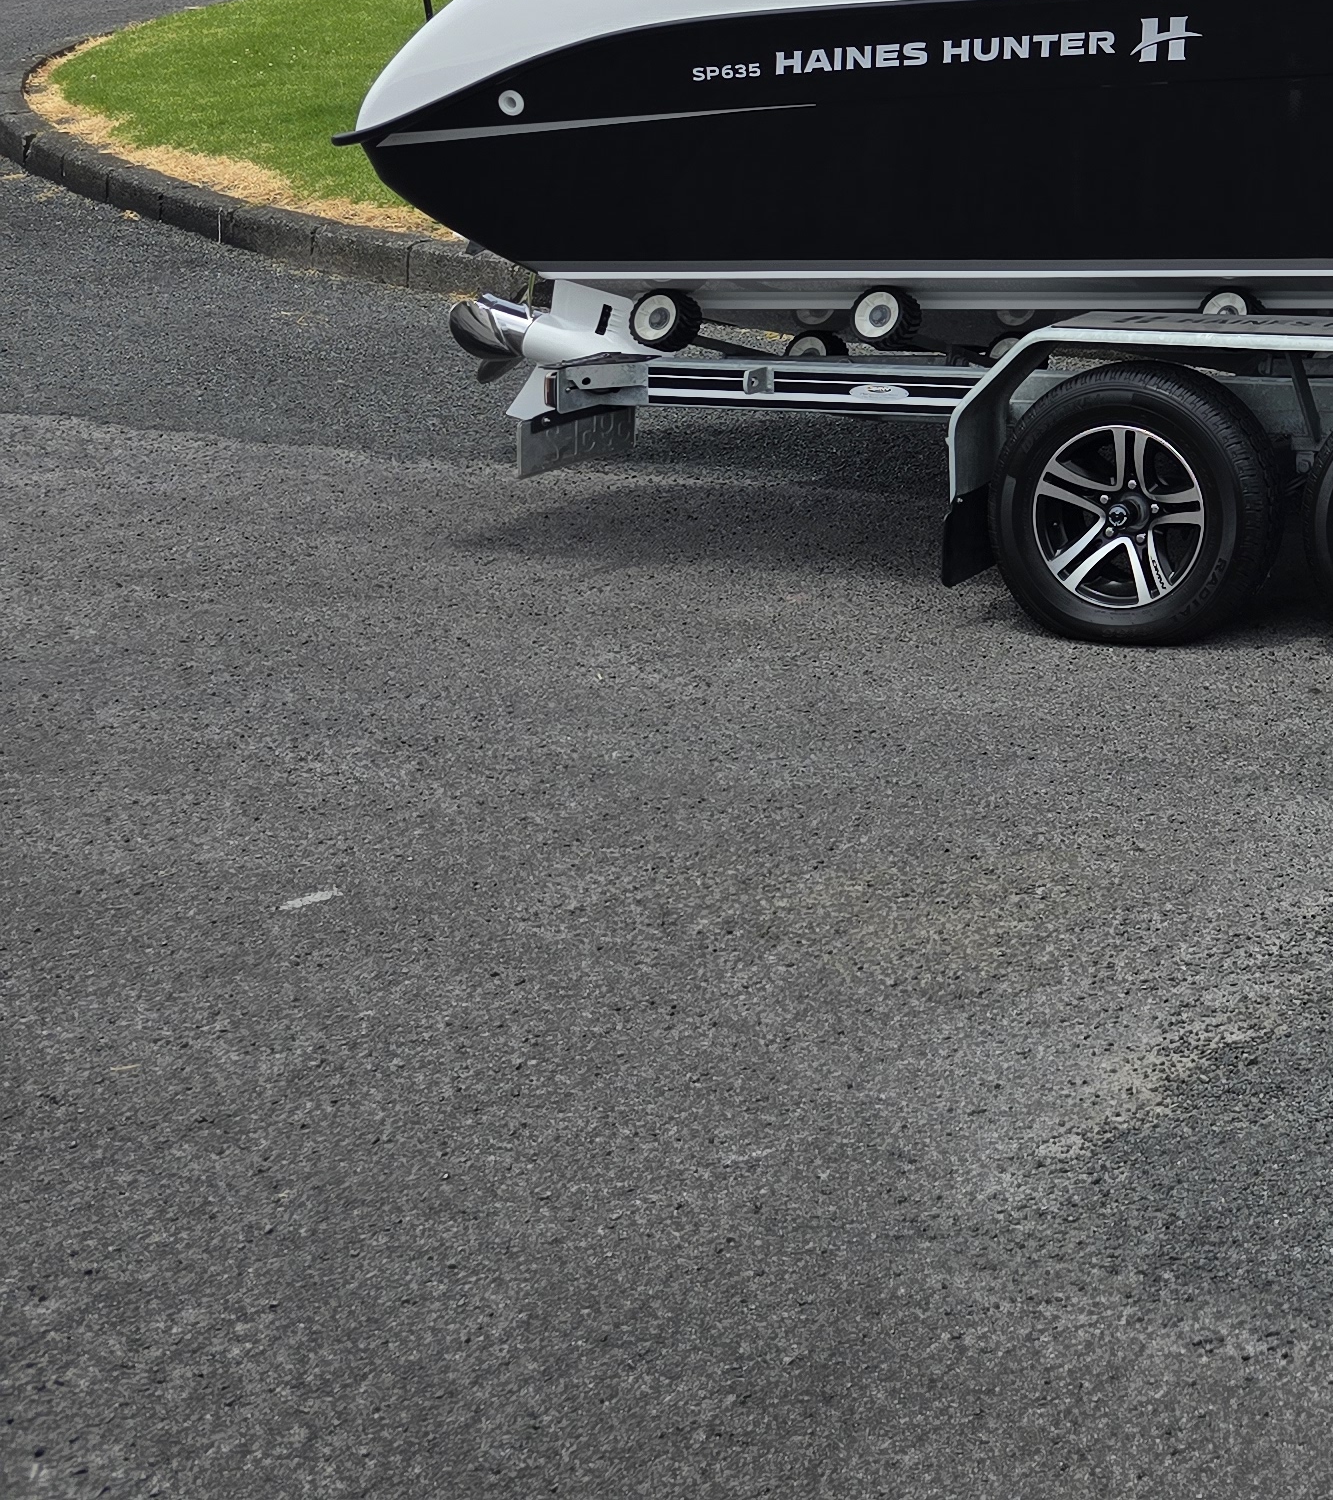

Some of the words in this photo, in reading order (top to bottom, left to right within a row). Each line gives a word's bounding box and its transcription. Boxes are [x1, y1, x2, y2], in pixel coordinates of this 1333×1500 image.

[692, 63, 761, 82] SP635
[775, 41, 927, 76] HAINES
[942, 30, 1115, 64] HUNTER
